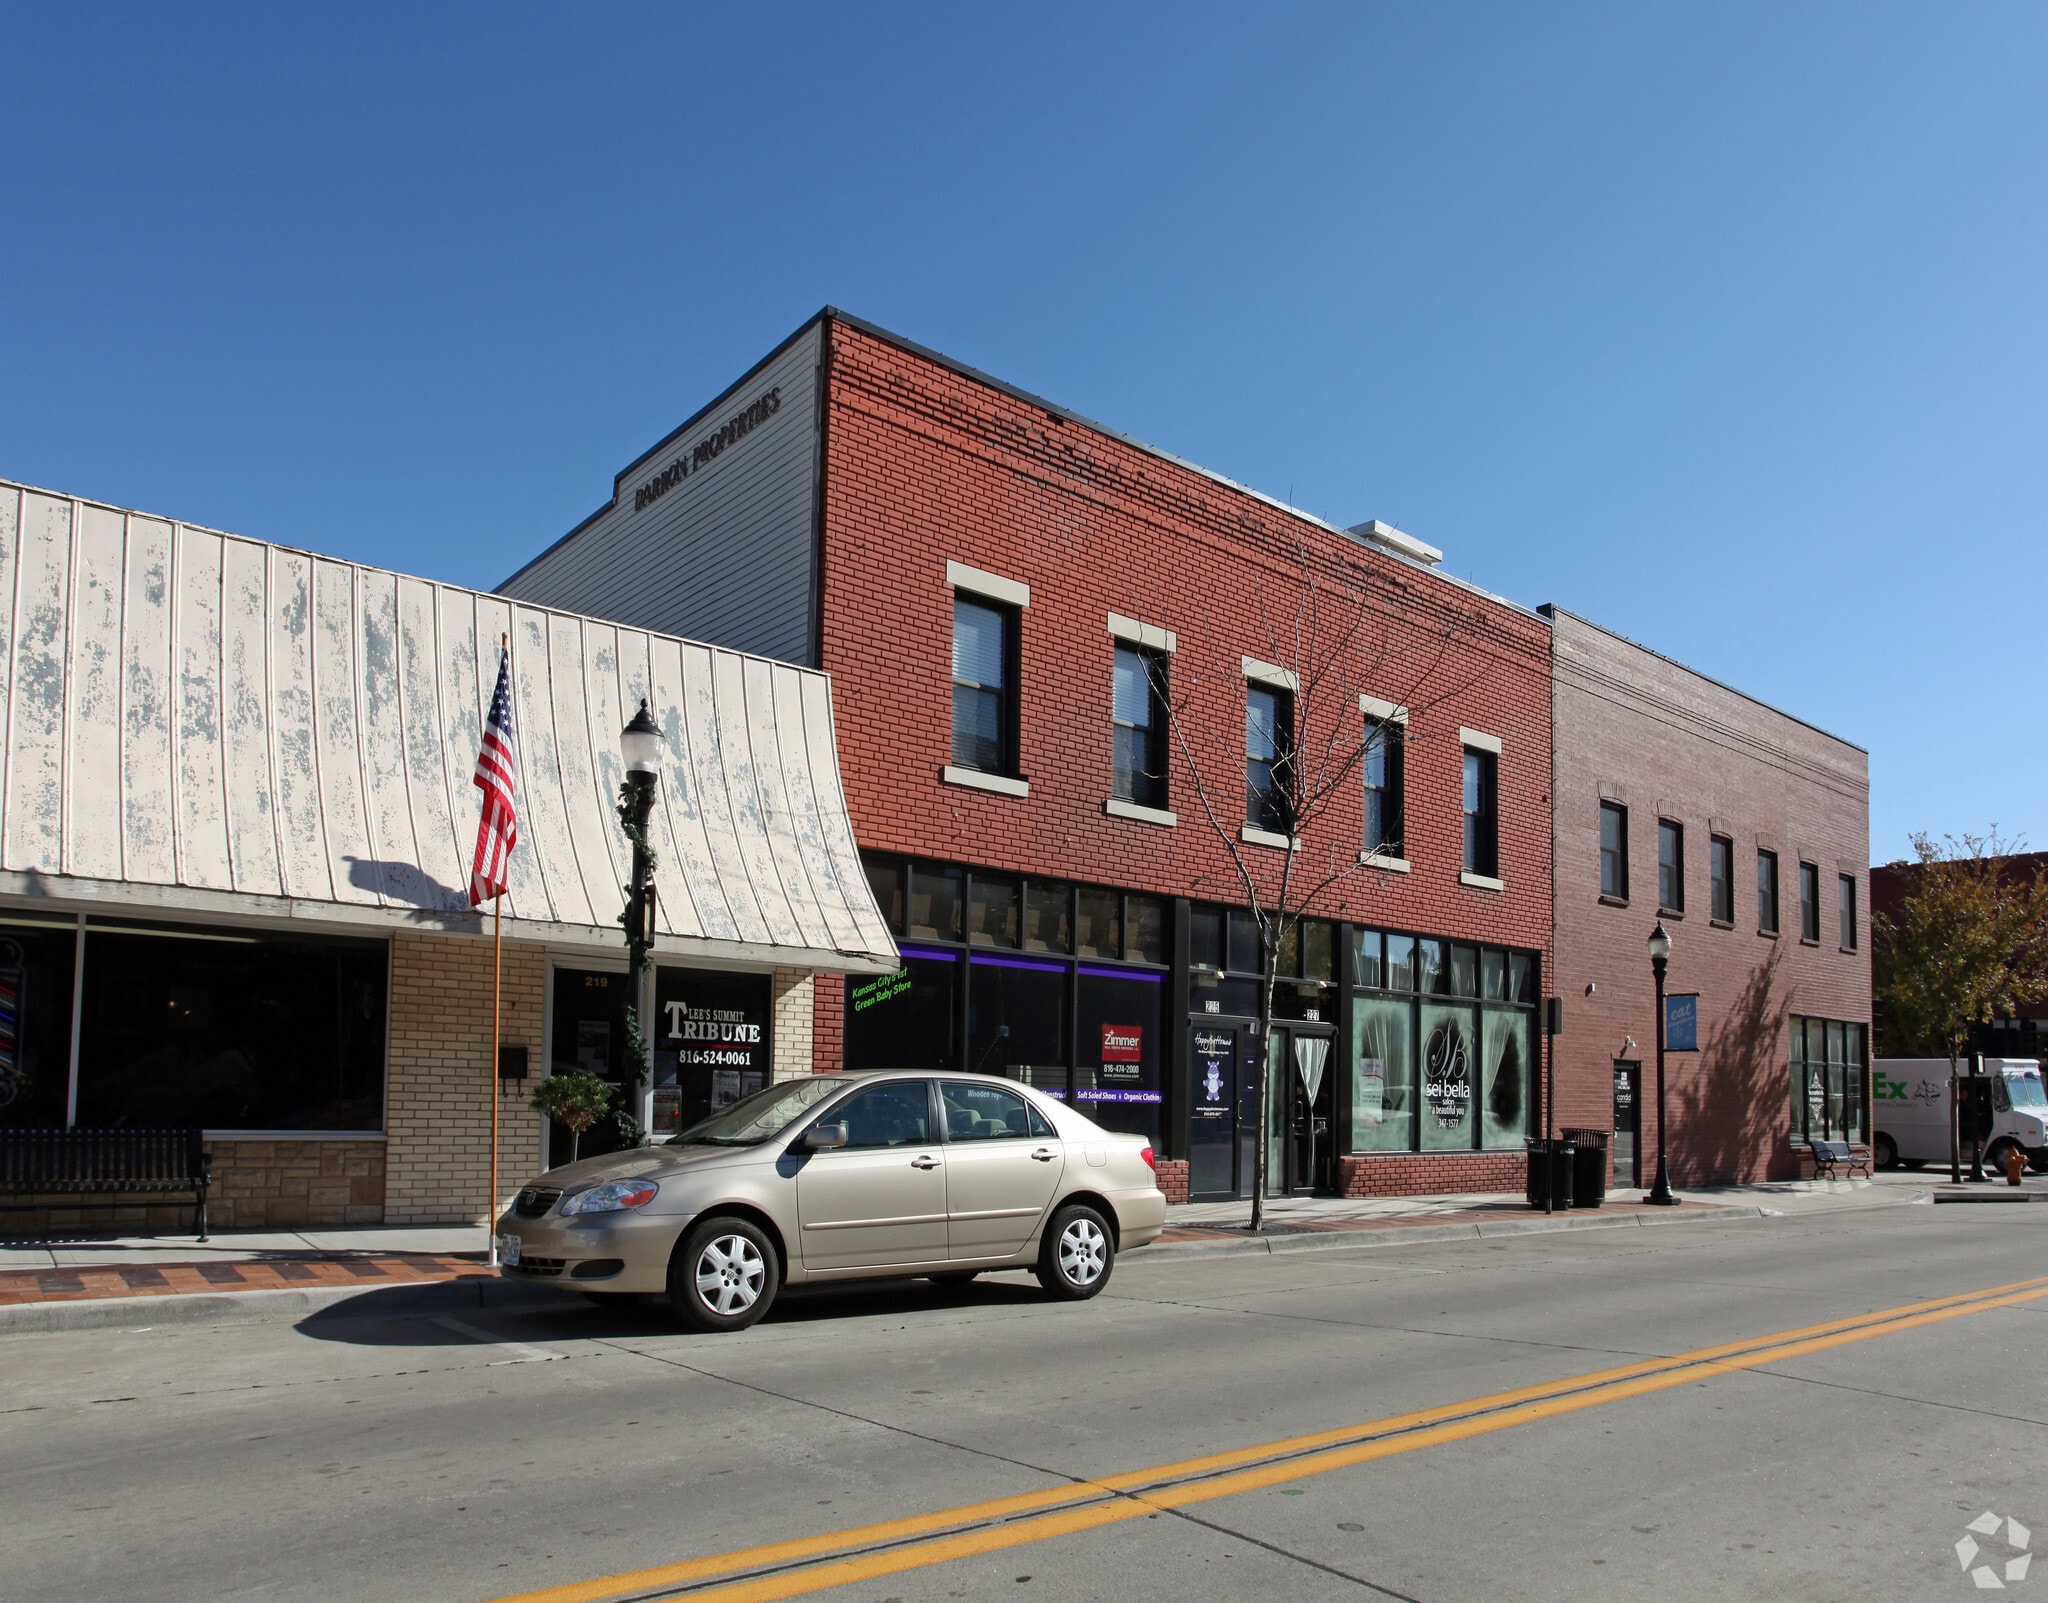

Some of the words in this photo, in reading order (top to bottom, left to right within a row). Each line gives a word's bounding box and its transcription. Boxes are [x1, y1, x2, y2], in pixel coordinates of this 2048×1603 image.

[693, 387, 781, 471] PROPERTIES
[585, 977, 608, 987] 219
[852, 982, 877, 999] Kansas
[877, 974, 896, 987] Citys
[855, 997, 875, 1011] Green
[876, 988, 893, 1002] Baby
[893, 981, 911, 995] Store
[688, 1008, 711, 1020] LEE'S
[712, 1009, 745, 1022] SUMMIT
[1671, 1002, 1692, 1021] eat
[664, 1001, 761, 1043] TRIBUNE
[1104, 1031, 1140, 1047] Zimmer
[680, 1050, 751, 1065] 816-524-0061
[1103, 1064, 1140, 1074] 816-474-2000
[967, 1089, 990, 1098] Wooden
[1426, 1080, 1442, 1097] sei
[1444, 1079, 1470, 1098] bella
[1077, 1091, 1087, 1099] Soft
[1088, 1091, 1102, 1100] Soled
[1102, 1092, 1117, 1100] Shoes
[1123, 1092, 1142, 1102] Organic
[1142, 1093, 1162, 1103] Clothing
[1436, 1105, 1456, 1115] beautiful
[1456, 1107, 1465, 1117] you
